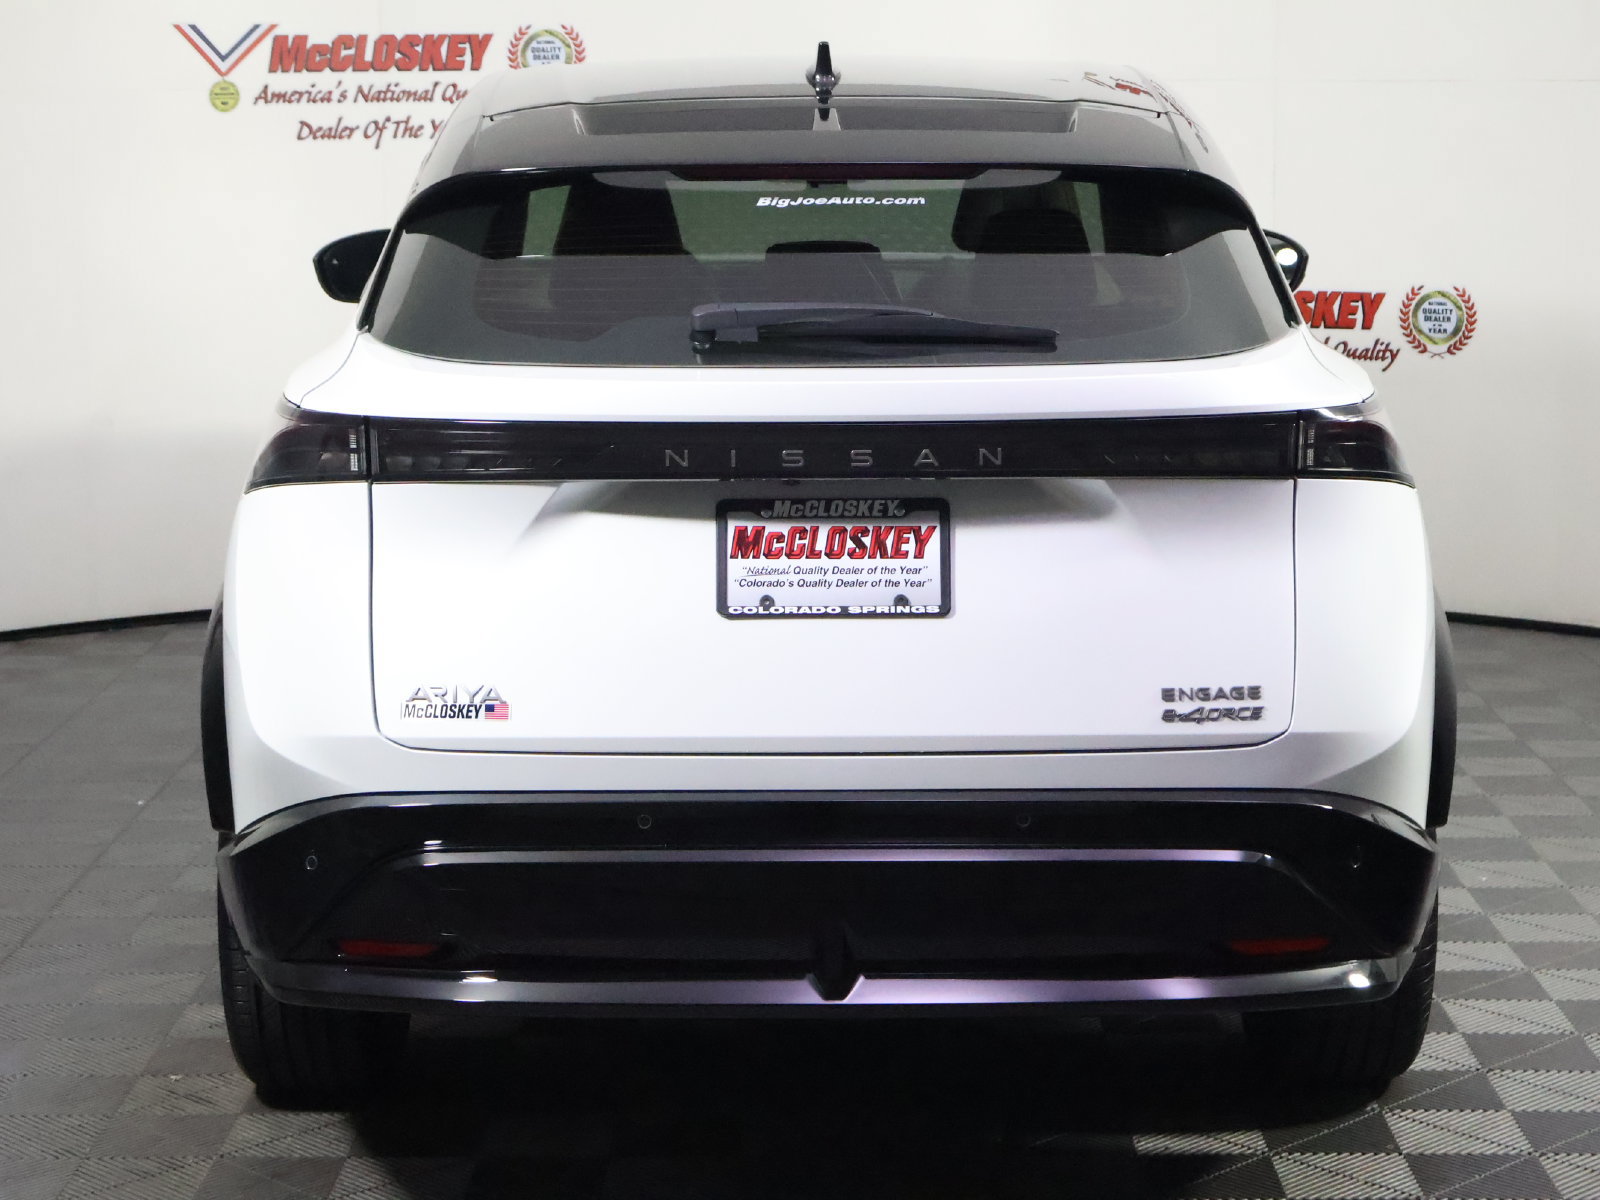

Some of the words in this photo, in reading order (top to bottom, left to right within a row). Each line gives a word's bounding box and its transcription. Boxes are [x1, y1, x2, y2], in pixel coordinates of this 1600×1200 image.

[268, 34, 493, 73] McCLOSKEY
[253, 80, 348, 105] America's
[354, 81, 440, 103] National
[297, 116, 360, 141] Dealer
[363, 116, 391, 149] Of
[392, 115, 424, 139] The
[756, 196, 926, 208] BigJoeAuto.com
[1422, 307, 1453, 315] QUALITY
[664, 447, 1003, 468] NISSAN
[773, 500, 899, 518] McCLOSKEY
[730, 525, 938, 560] McCLOSKEY
[793, 566, 829, 576] Quality
[832, 566, 864, 575] Dealer
[867, 566, 878, 575] of
[880, 566, 896, 575] the
[797, 579, 833, 589] Quality
[836, 579, 868, 588] Dealer
[871, 579, 882, 588] of
[884, 579, 900, 588] the
[728, 606, 842, 615] COLORADO
[848, 605, 940, 614] SPRINGS
[405, 684, 507, 704] ARIYA
[1161, 685, 1262, 702] ENGAGE
[403, 703, 483, 719] McCLOSKEY
